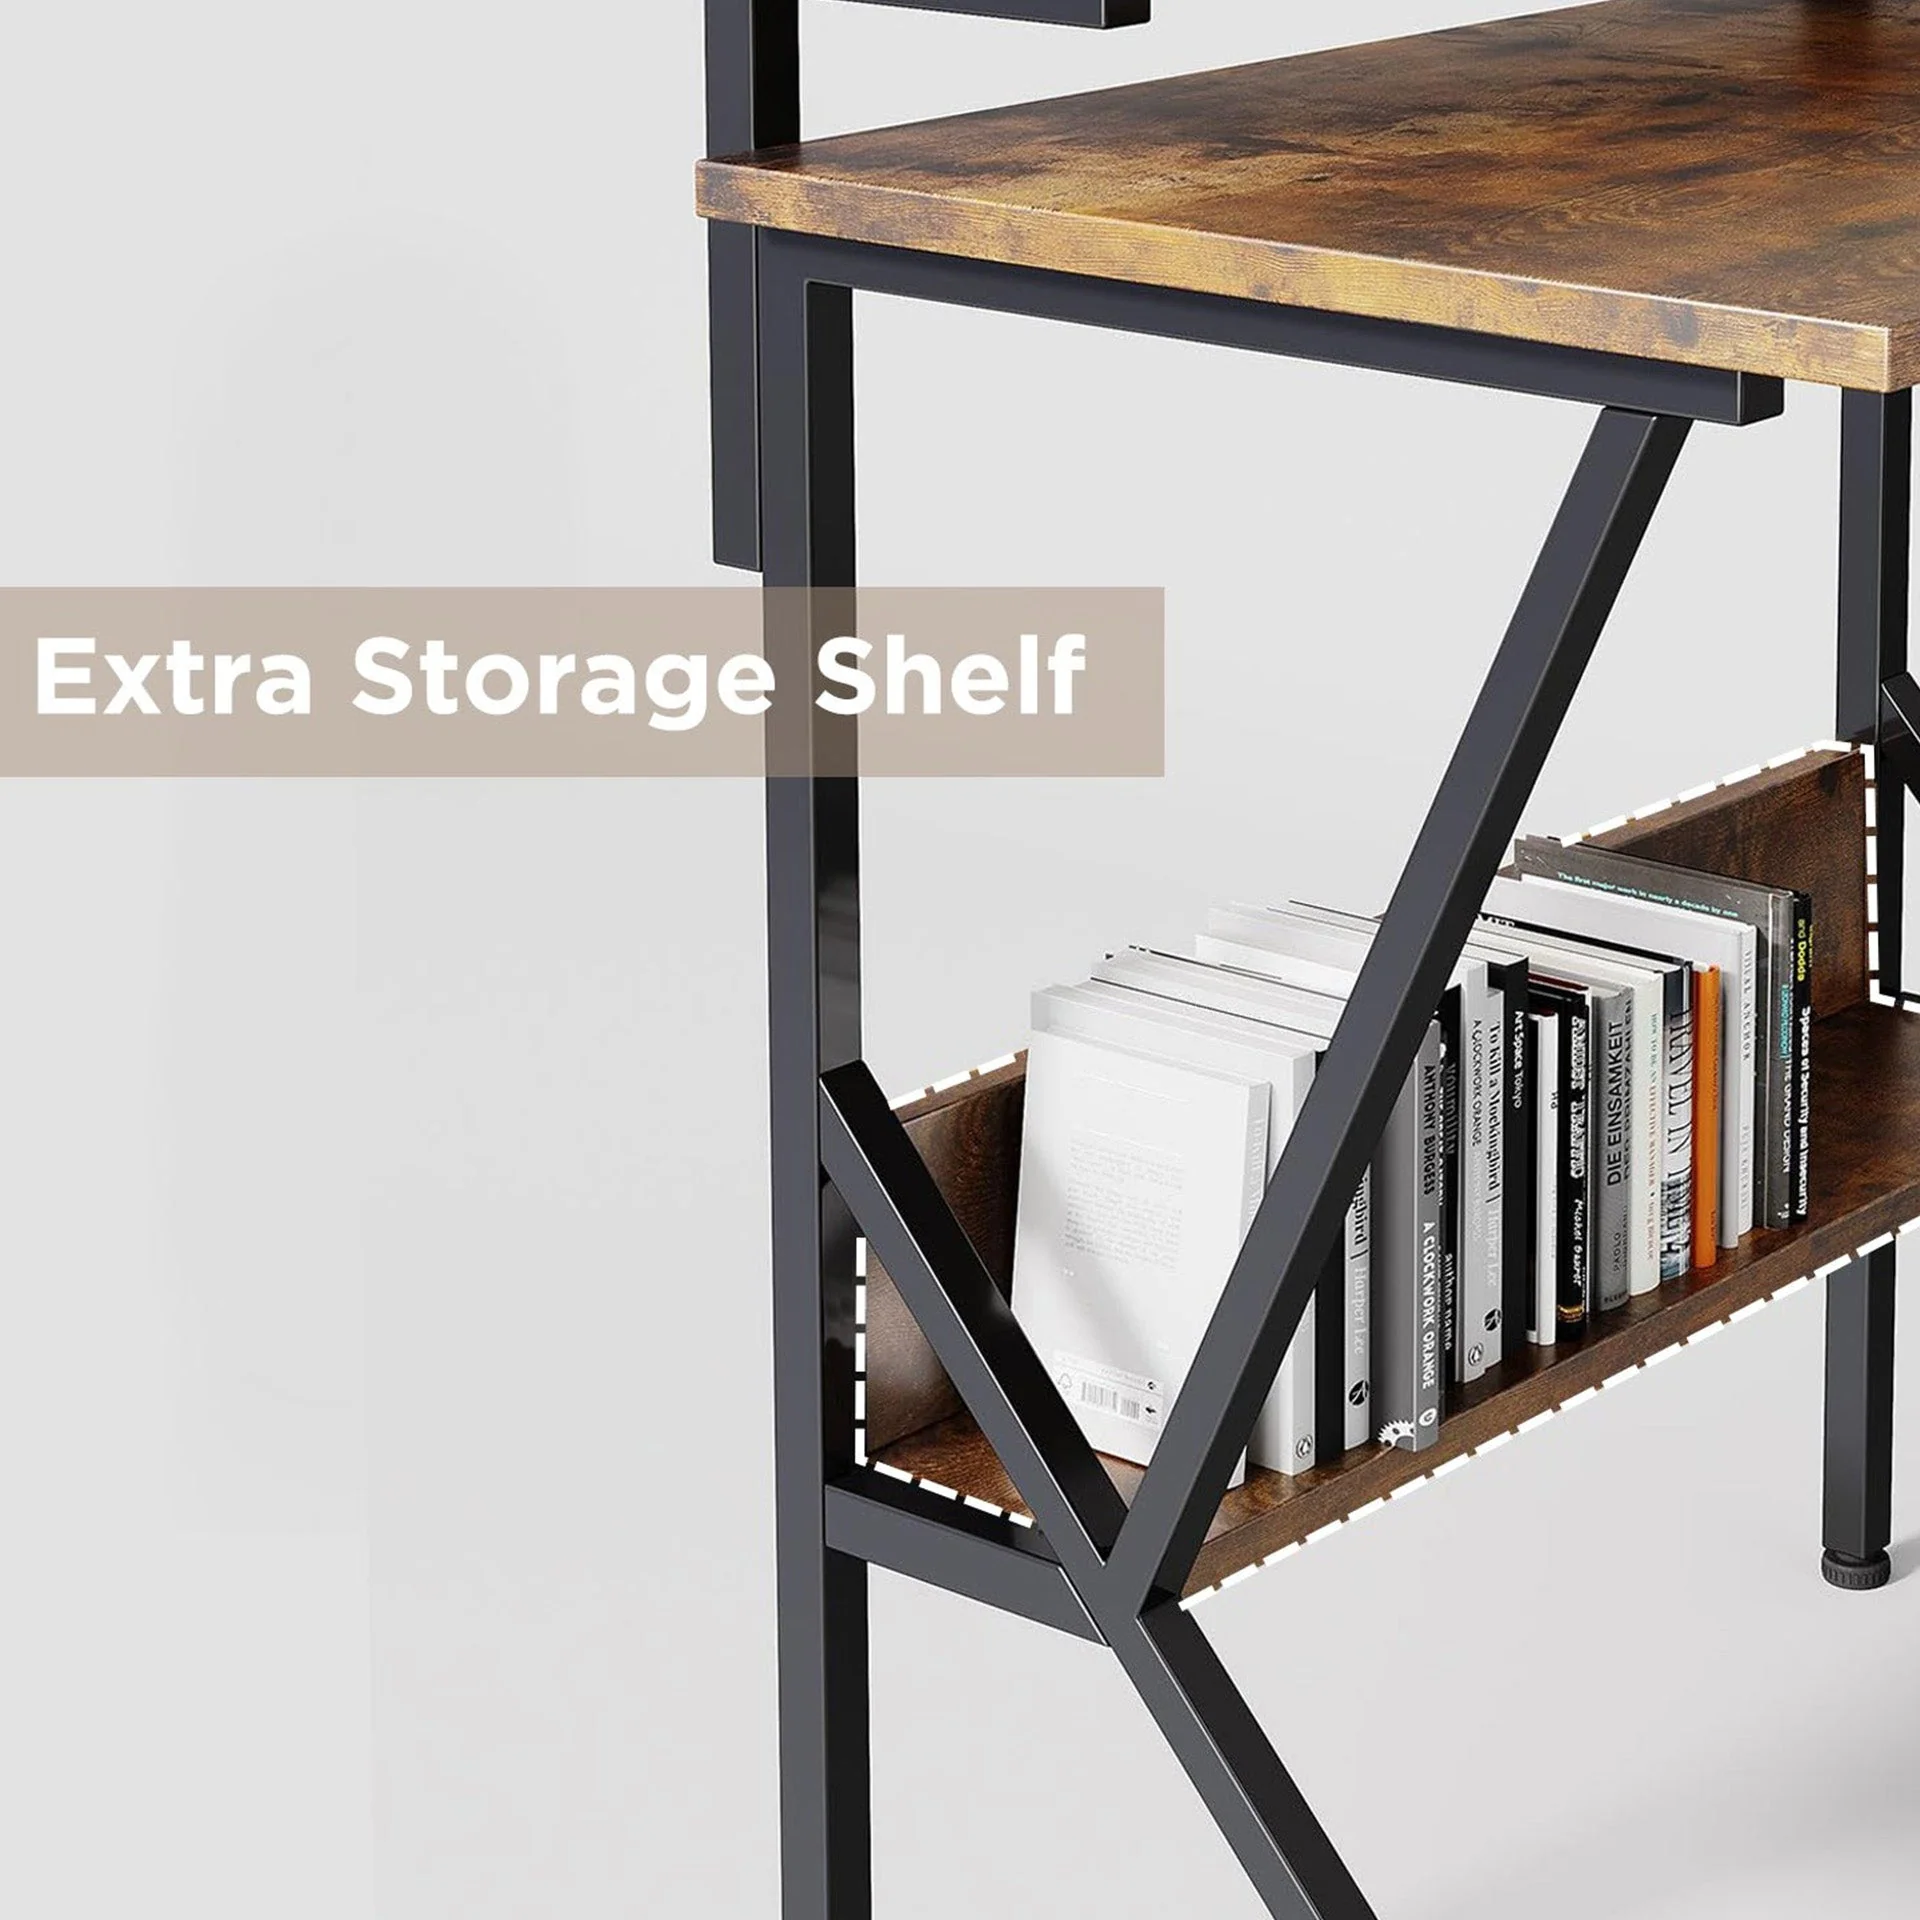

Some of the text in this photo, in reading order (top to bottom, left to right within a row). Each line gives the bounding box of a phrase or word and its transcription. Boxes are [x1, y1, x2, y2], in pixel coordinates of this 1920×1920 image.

[1472, 1019, 1483, 1028] A
[1489, 1020, 1501, 1044] To
[1668, 1006, 1693, 1117] TRAVEL
[1472, 1029, 1483, 1099] CLOCKWORK
[1489, 1078, 1498, 1088] a
[1423, 1065, 1436, 1196] ANTHONY BURGESS
[1471, 1100, 1482, 1147] ORANGE
[1486, 1090, 1501, 1192] Mockingbird
[1607, 1021, 1623, 1187] DIE EINSAMKEIT
[1668, 1121, 1692, 1155] IN
[1353, 1267, 1368, 1356] Harper Lee
[1422, 1221, 1436, 1390] A CLOCKWORK ORANGE
